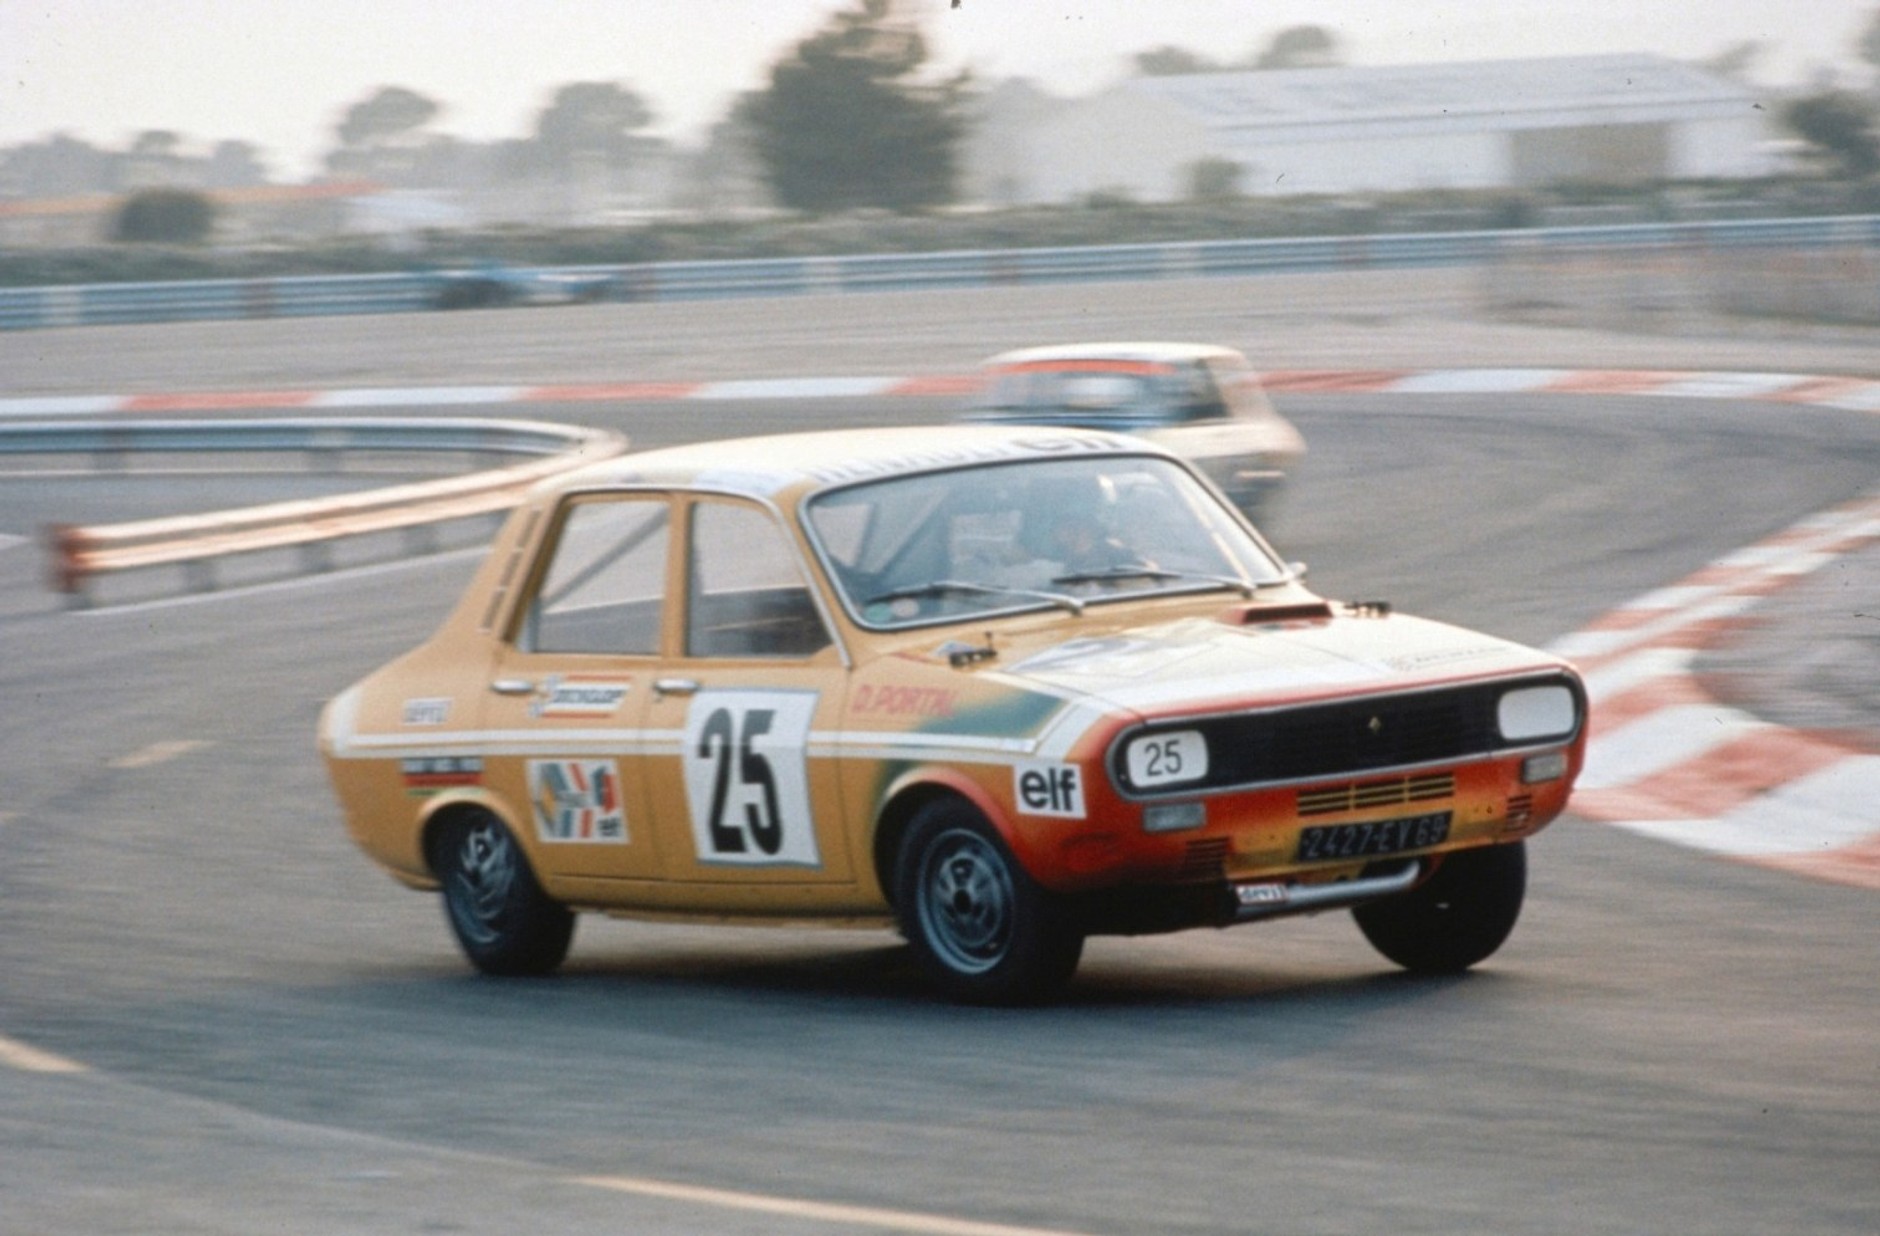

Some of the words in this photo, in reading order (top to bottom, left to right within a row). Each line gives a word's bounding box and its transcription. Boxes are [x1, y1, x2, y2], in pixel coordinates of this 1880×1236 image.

[1145, 739, 1182, 776] 25
[698, 708, 782, 855] 25
[1019, 767, 1075, 812] elf
[1307, 824, 1372, 857] 2427
[1415, 815, 1446, 845] 69
